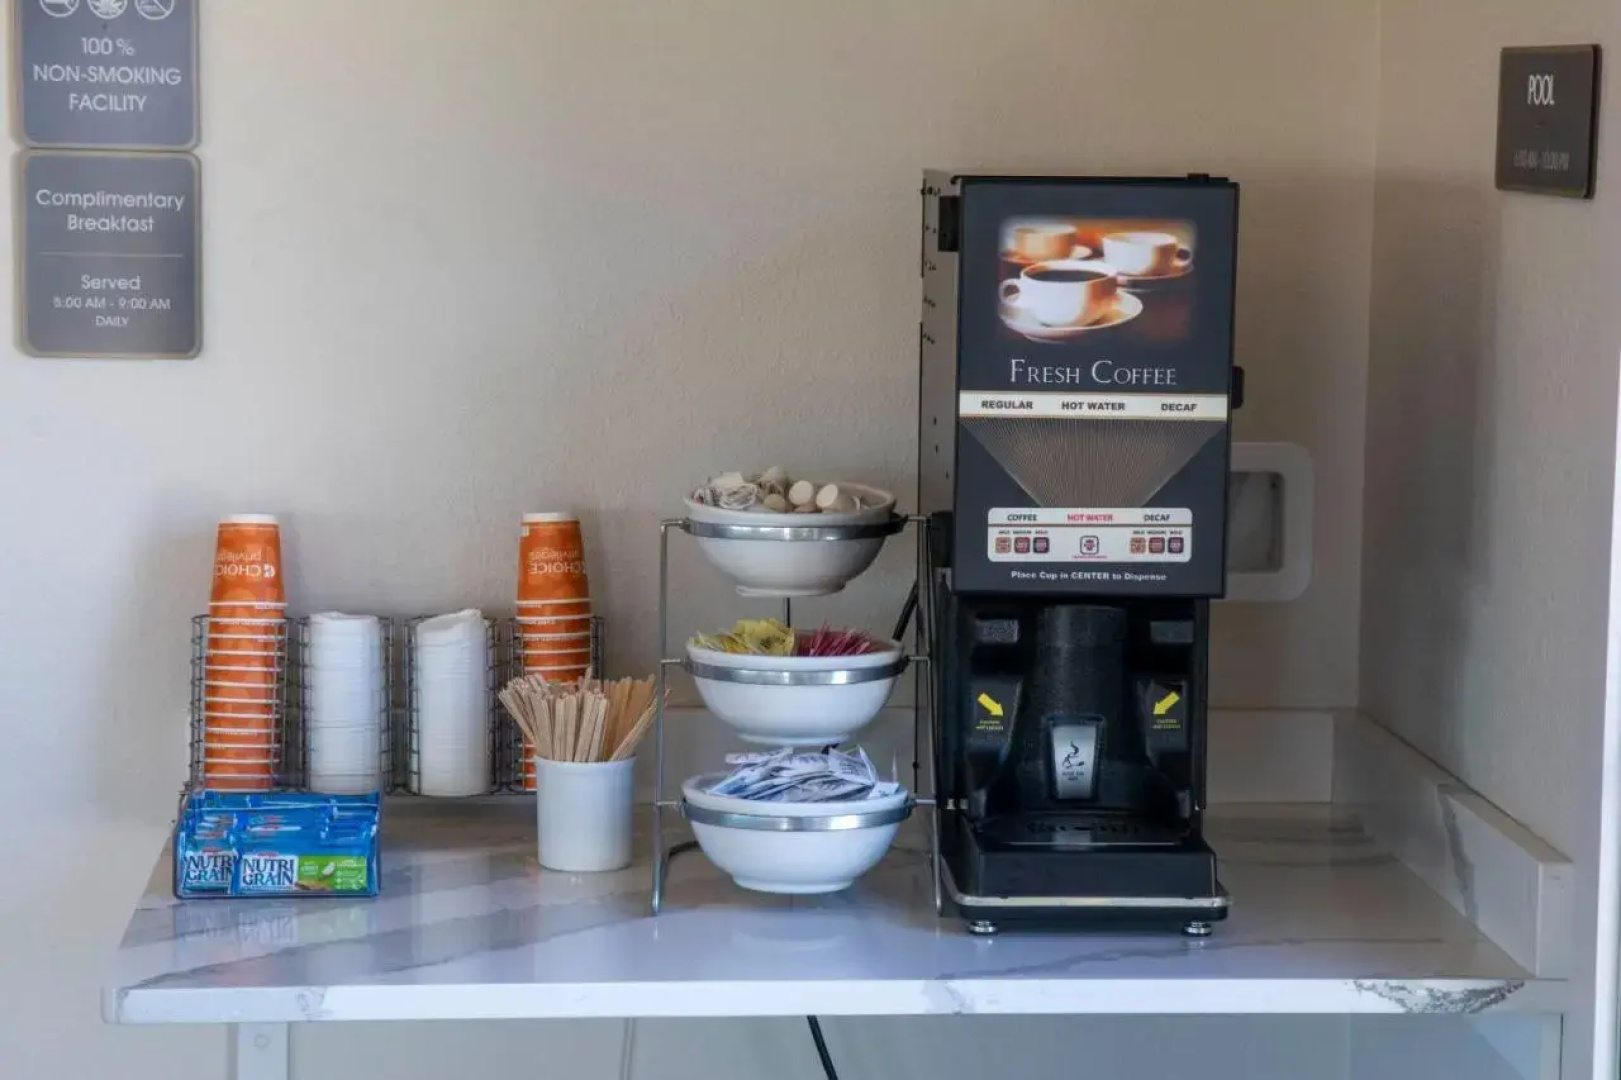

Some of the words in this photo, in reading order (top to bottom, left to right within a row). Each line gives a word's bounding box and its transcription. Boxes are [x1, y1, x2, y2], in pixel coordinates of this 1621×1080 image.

[81, 37, 112, 55] 100
[115, 38, 135, 56] %
[33, 64, 182, 85] NON-SMOKING
[1527, 74, 1555, 105] POOL
[69, 93, 147, 111] FACILITY
[36, 189, 185, 211] Complimentary
[66, 214, 155, 232] Breakfast
[81, 275, 141, 290] Served
[85, 297, 106, 309] AM
[119, 297, 147, 310] 9:00
[149, 298, 171, 310] AM
[95, 315, 129, 327] DAILY
[1010, 358, 1080, 384] FRESH
[1091, 360, 1177, 385] COFFEE
[981, 400, 1033, 410] REGULAR
[1062, 401, 1085, 411] HOT
[1088, 402, 1125, 411] WATER
[1161, 403, 1197, 412] DECAF
[1007, 513, 1037, 521] COFFEE
[1067, 513, 1085, 522] HOT
[1086, 514, 1113, 522] WATER
[214, 564, 262, 576] CHOIC
[1011, 570, 1036, 578] Place
[1039, 571, 1057, 580] Cup
[1060, 571, 1068, 579] in
[1071, 571, 1109, 580] CENTER
[1112, 572, 1121, 580] to
[1125, 572, 1167, 582] Dispense
[243, 859, 295, 872] NUTRI
[243, 871, 294, 885] GRAIN
